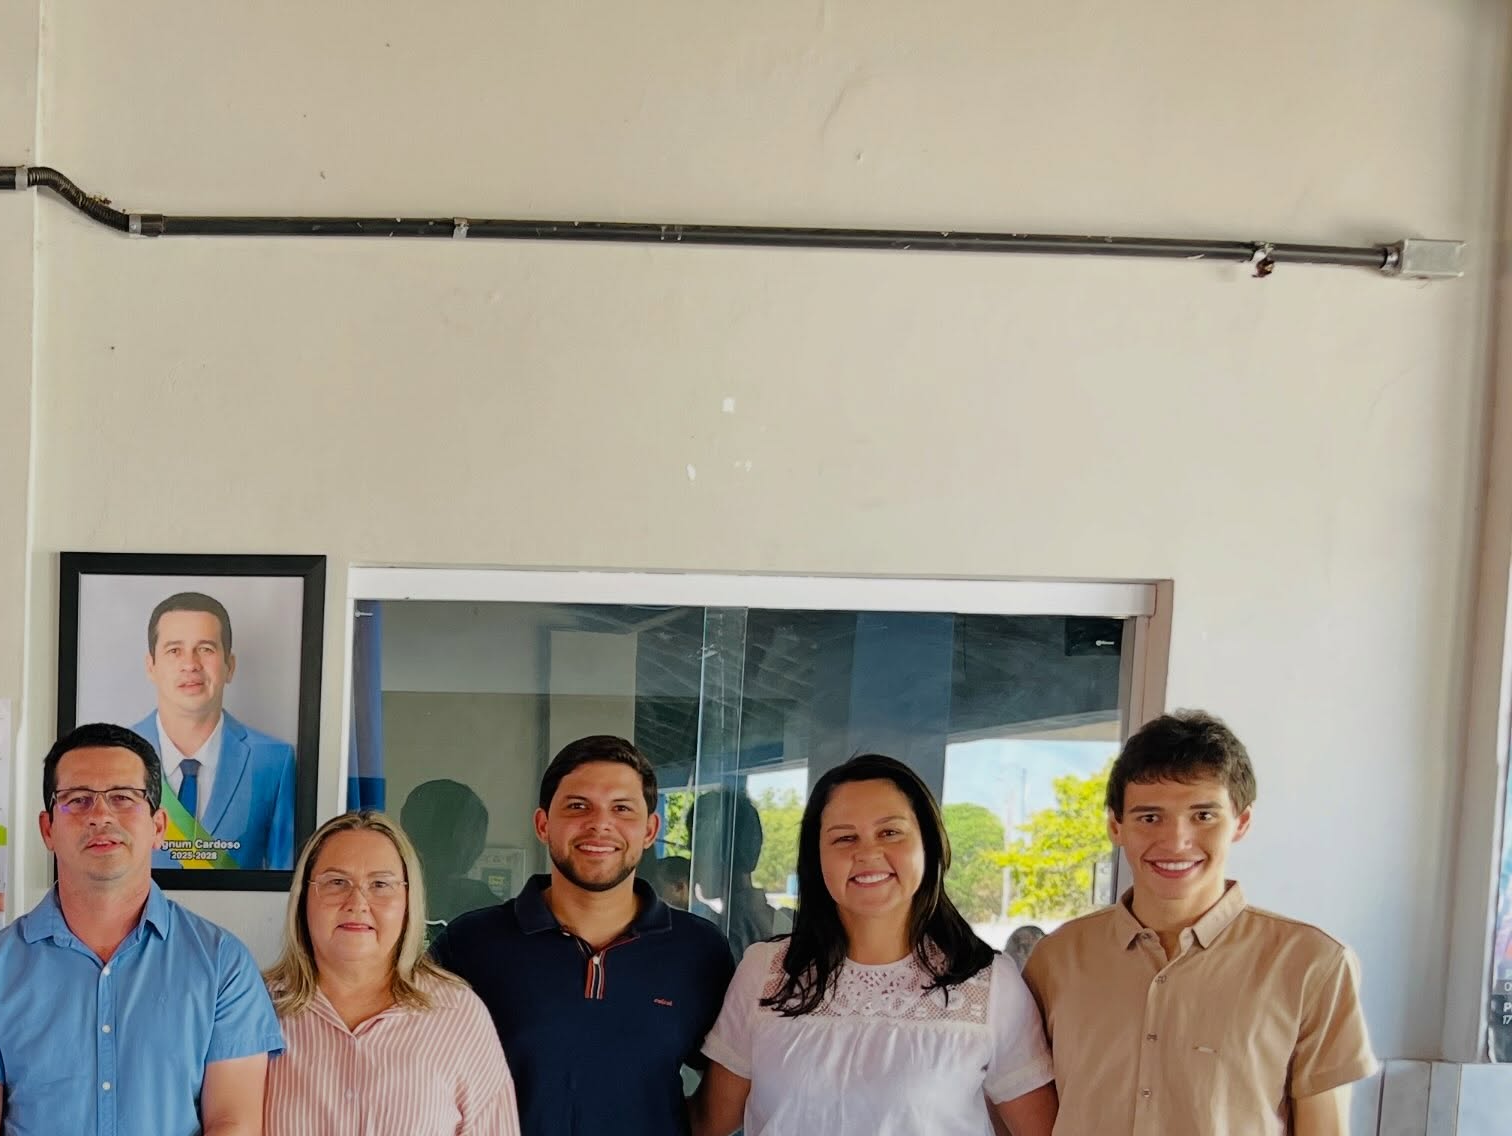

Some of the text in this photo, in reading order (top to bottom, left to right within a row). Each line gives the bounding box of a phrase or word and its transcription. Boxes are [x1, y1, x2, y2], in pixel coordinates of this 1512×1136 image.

[161, 839, 241, 850] gnum Cardoso
[171, 851, 217, 860] 2025-2028
